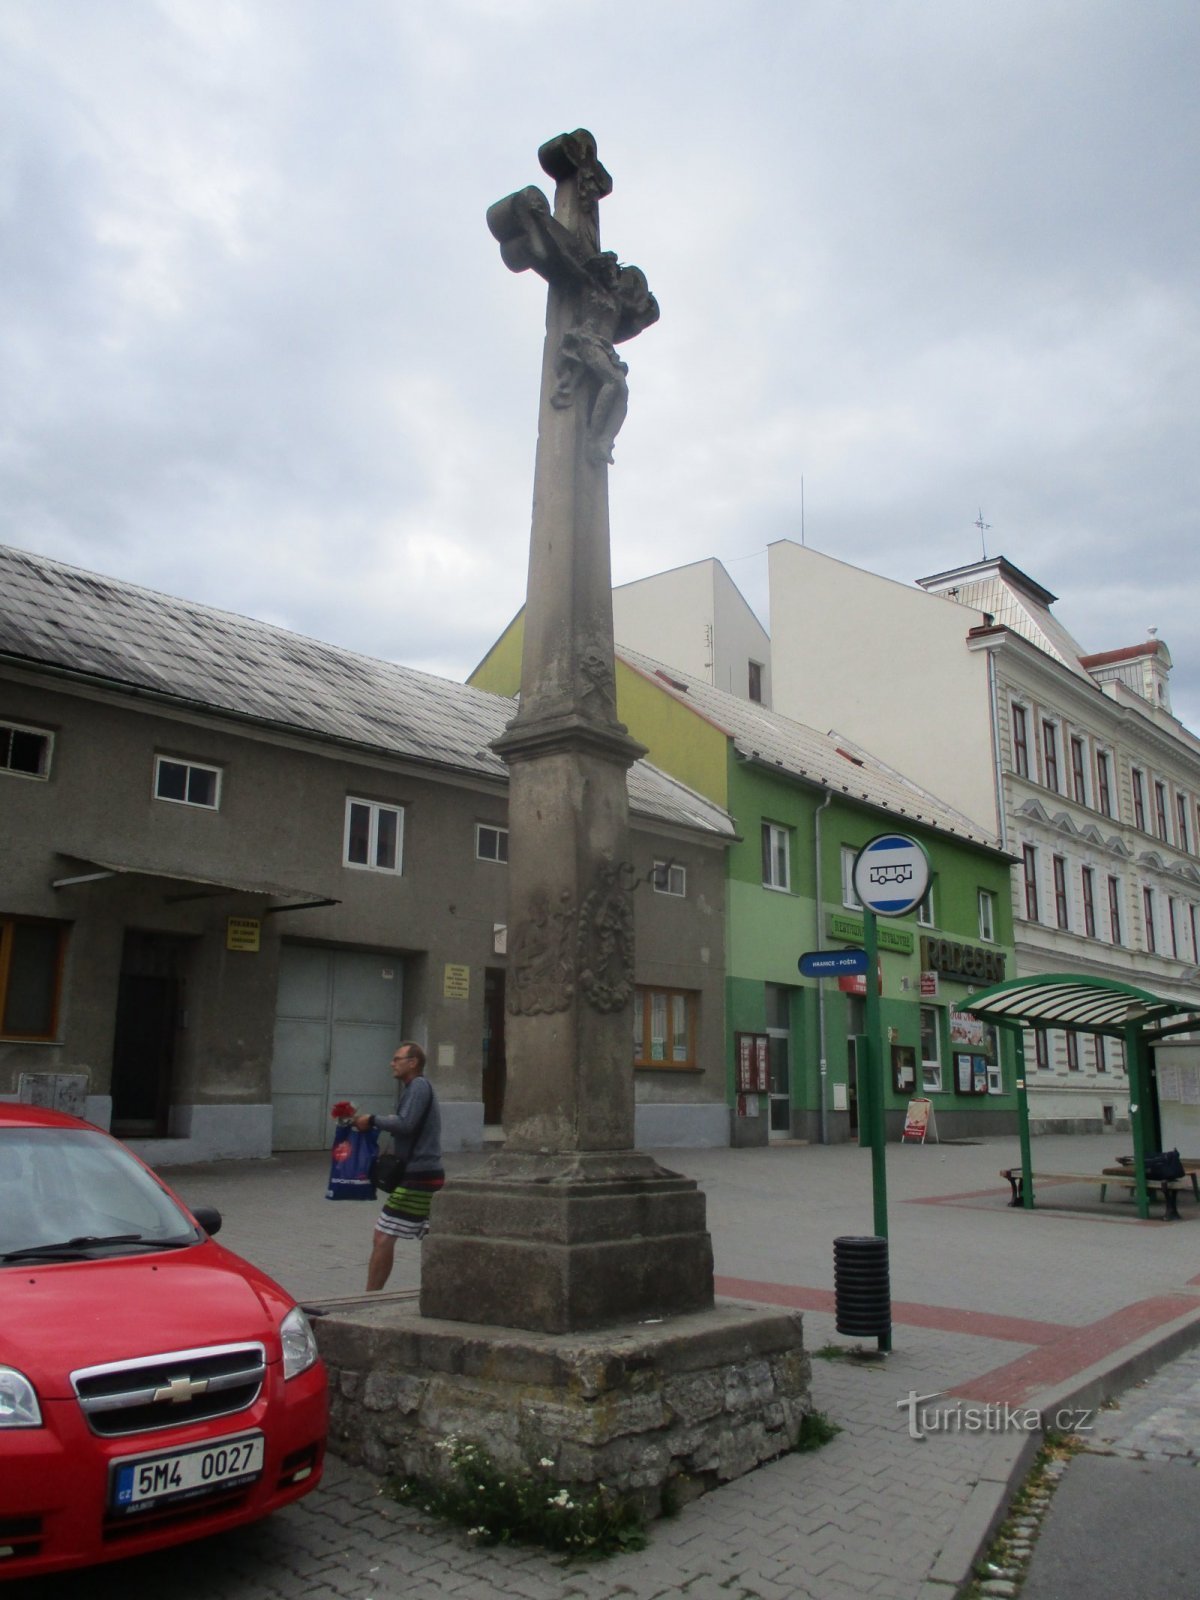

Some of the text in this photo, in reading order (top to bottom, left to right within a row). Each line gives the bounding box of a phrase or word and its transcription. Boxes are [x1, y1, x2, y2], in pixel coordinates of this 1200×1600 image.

[812, 960, 836, 969] HRANICE
[839, 958, 857, 966] POŠTA
[139, 1443, 254, 1494] 5M4 0027
[118, 1488, 132, 1501] CZ
